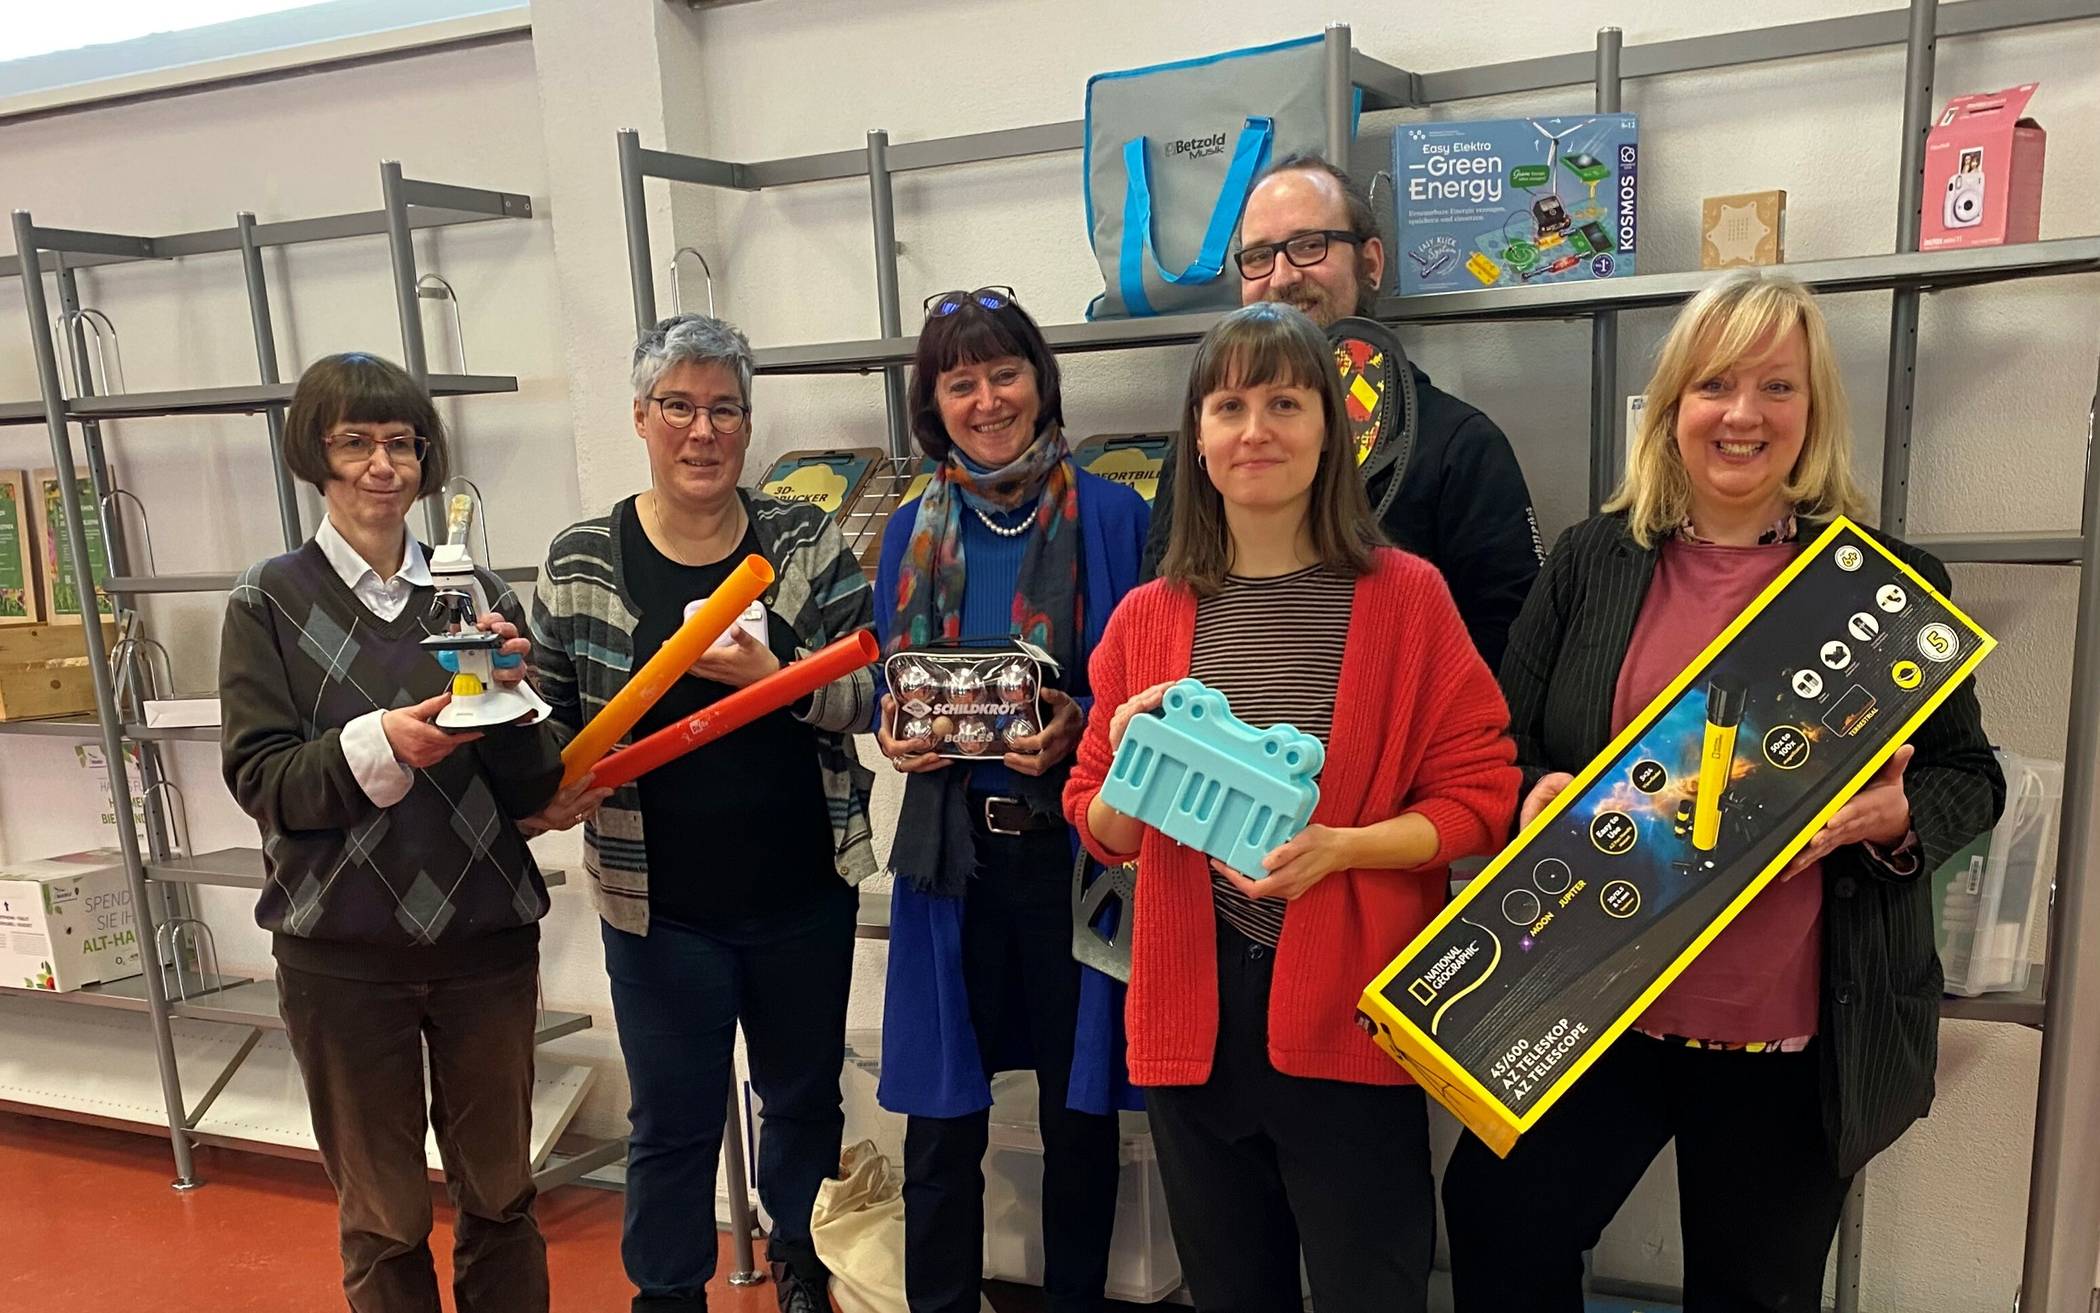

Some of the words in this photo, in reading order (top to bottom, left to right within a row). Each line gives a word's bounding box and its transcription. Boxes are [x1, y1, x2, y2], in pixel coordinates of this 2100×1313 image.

[1176, 133, 1226, 154] Betzold
[1423, 144, 1450, 155] Easy
[1453, 142, 1491, 152] Elektro
[1409, 177, 1502, 203] Energy
[1620, 175, 1635, 251] KOSMOS
[774, 486, 795, 495] 3D-
[774, 493, 829, 502] RUCKER
[1926, 630, 1949, 653] 5
[932, 701, 1019, 715] SCHILDKRÖT
[943, 731, 994, 743] BOULES
[1778, 740, 1797, 756] 100x
[1781, 733, 1791, 742] to
[1595, 823, 1612, 838] Easy
[1610, 815, 1619, 824] to
[1606, 826, 1622, 839] Use
[85, 890, 131, 913] SPEND
[1558, 879, 1587, 909] JUPITER
[97, 912, 117, 931] SIE
[1529, 911, 1555, 938] MOON
[83, 929, 136, 954] ALT-HA
[1423, 945, 1463, 983] NATIONAL
[1432, 940, 1481, 990] GEOGRAPHIC
[1490, 1039, 1530, 1079] 45/600
[1502, 1073, 1521, 1090] AZ
[1515, 1018, 1570, 1082] TELESKOP
[1513, 1084, 1532, 1100] AZ
[1528, 1022, 1589, 1092] TELESCOPE
